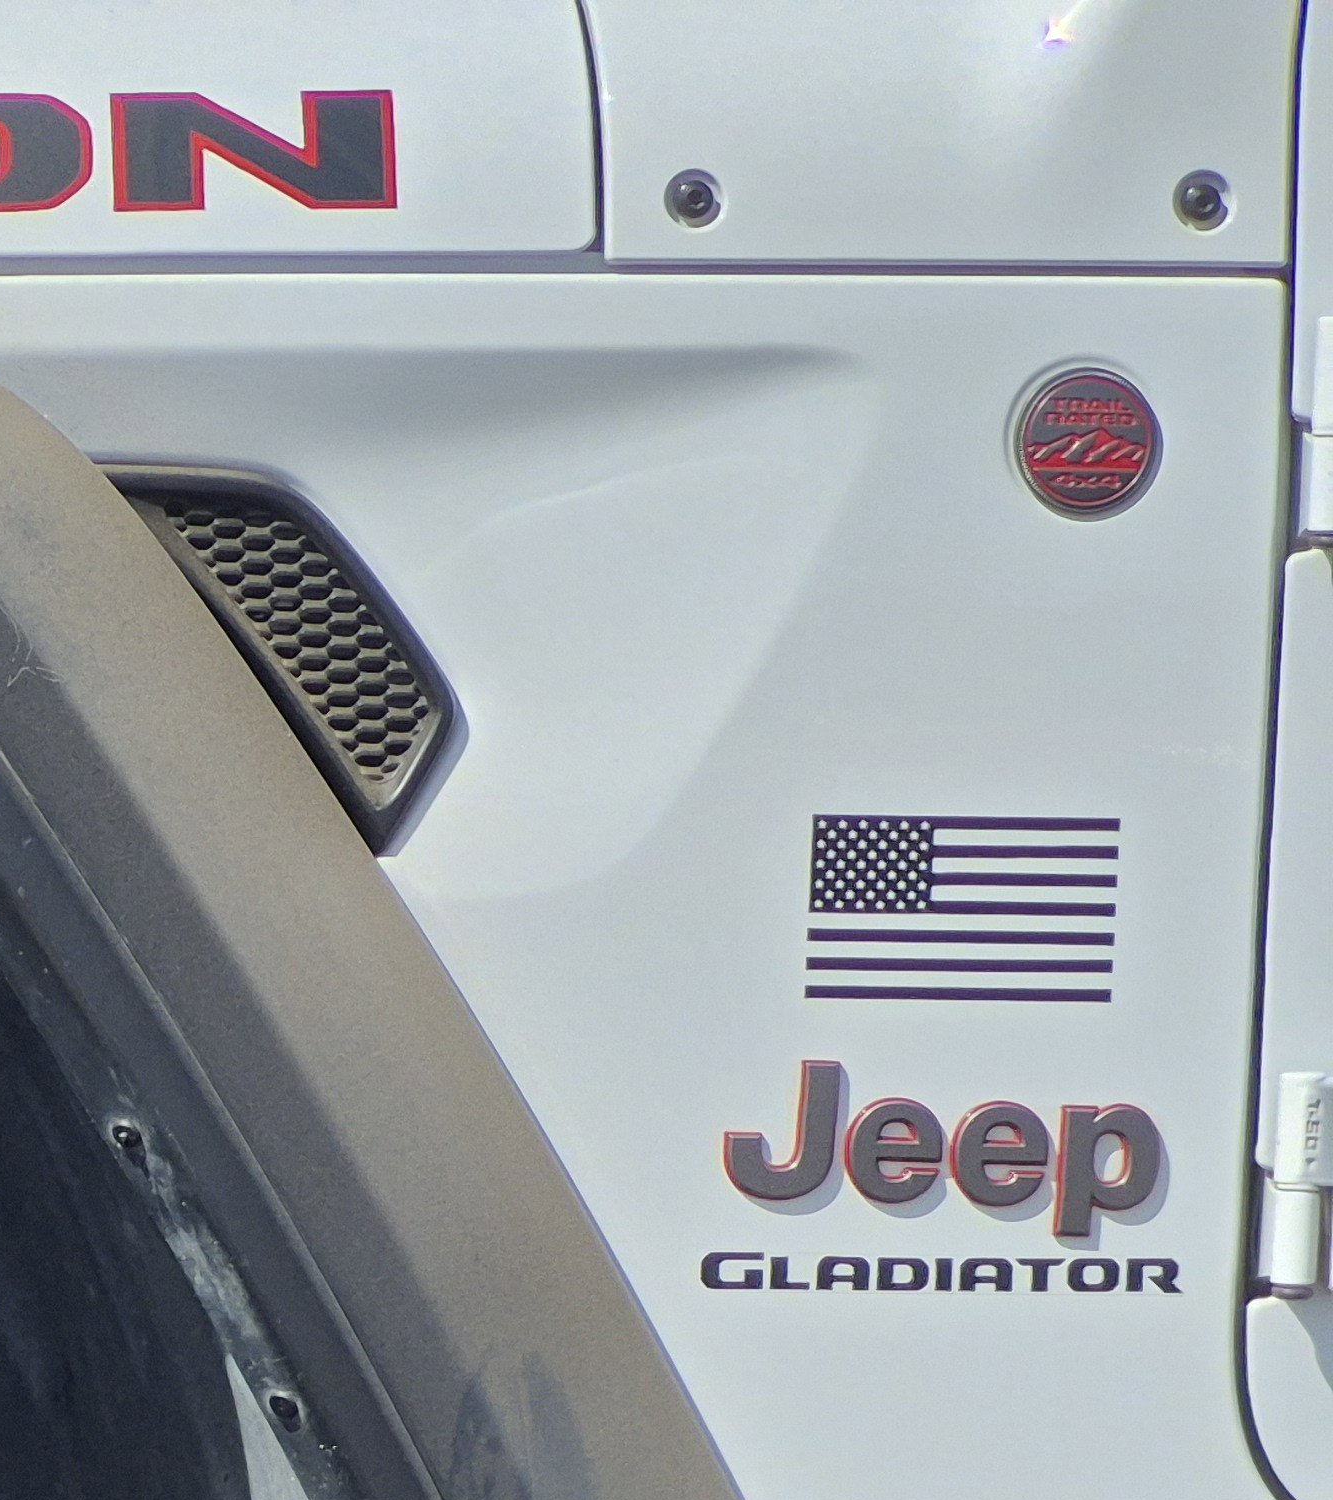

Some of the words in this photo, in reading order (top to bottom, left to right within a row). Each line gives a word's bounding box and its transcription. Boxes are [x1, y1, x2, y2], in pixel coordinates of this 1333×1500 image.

[1044, 413, 1138, 426] RATED
[1054, 397, 1132, 413] TRAIL
[723, 1060, 1162, 1238] Jeep
[700, 1251, 1183, 1294] GLADIATOR
